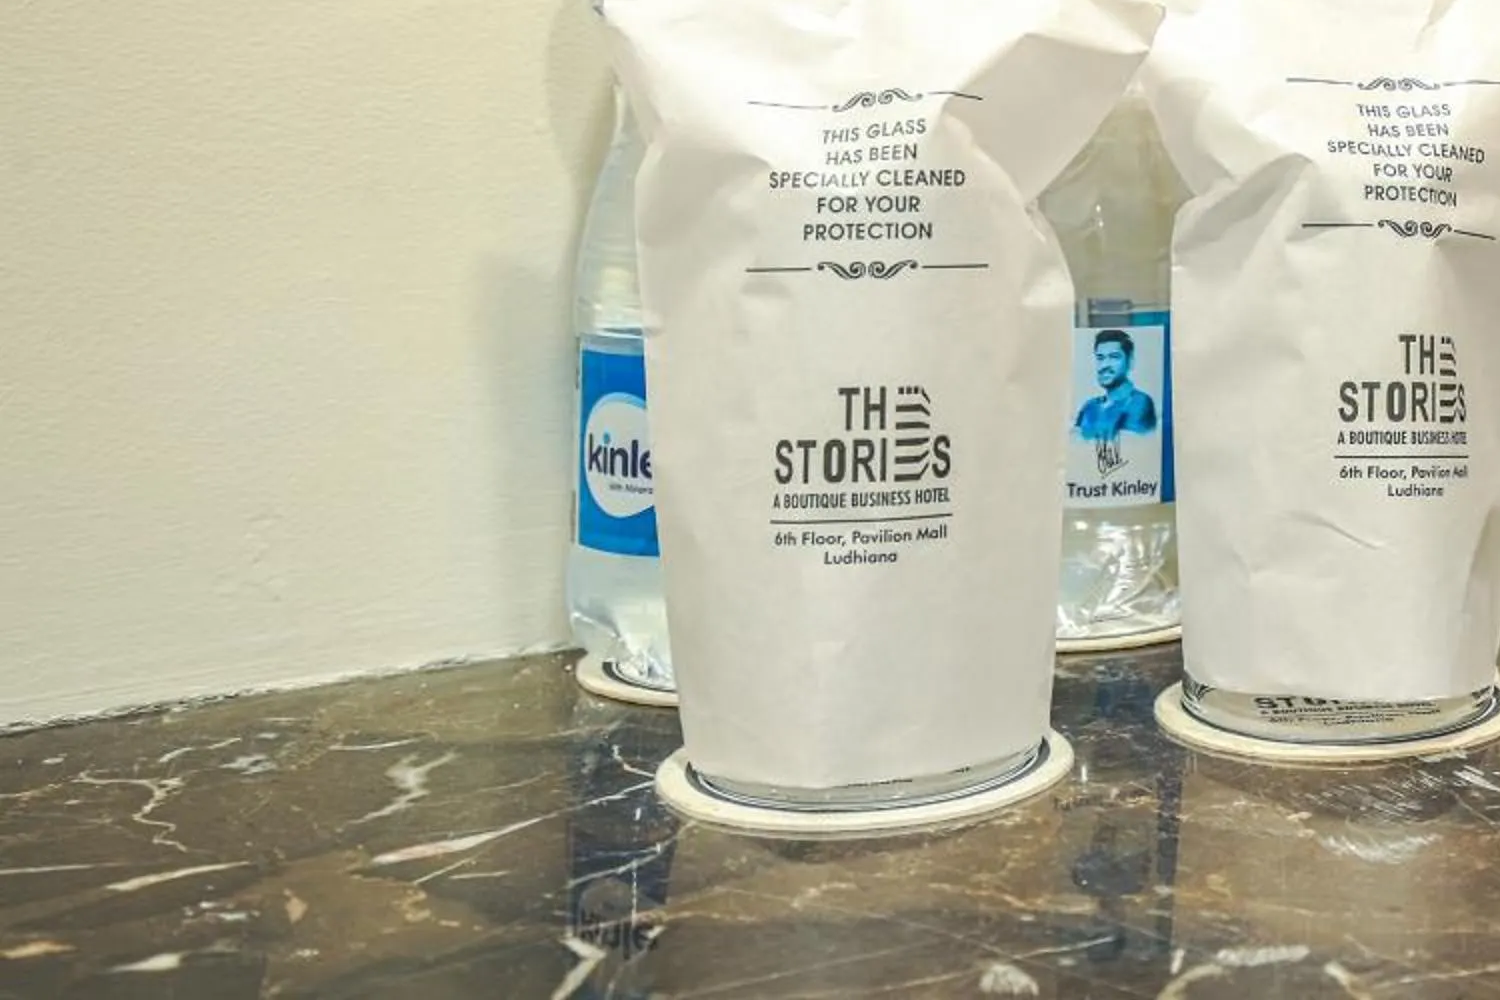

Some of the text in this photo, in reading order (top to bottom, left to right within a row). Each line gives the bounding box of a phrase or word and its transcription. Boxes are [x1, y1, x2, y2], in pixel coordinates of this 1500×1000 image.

[1356, 103, 1451, 118] THIS GLASS
[822, 119, 927, 144] THIS GLASS
[1367, 123, 1449, 137] HAS BEEN
[826, 144, 918, 166] HAS BEEN
[1327, 140, 1485, 164] SPECIALLY CLEANED
[769, 169, 966, 189] SPECIALLY CLEANED
[1373, 163, 1453, 183] FOR YOUR
[817, 195, 921, 214] FOR YOUR
[1364, 184, 1457, 207] PROTECTION
[803, 222, 933, 241] PROTECTION
[1337, 381, 1467, 423] STORIES
[1337, 432, 1345, 445] A
[1349, 431, 1407, 445] BOUTIQUE
[774, 434, 951, 485] STORIES
[1339, 466, 1363, 479] 6th
[1367, 466, 1407, 481] Floor,
[773, 487, 950, 510] A BOUTIQUE BUSINESS HOTEL
[1066, 479, 1158, 498] Trust Kinley
[775, 524, 947, 548] 6th Floor, Pavilion Mall
[823, 549, 898, 566] Ludhiana
